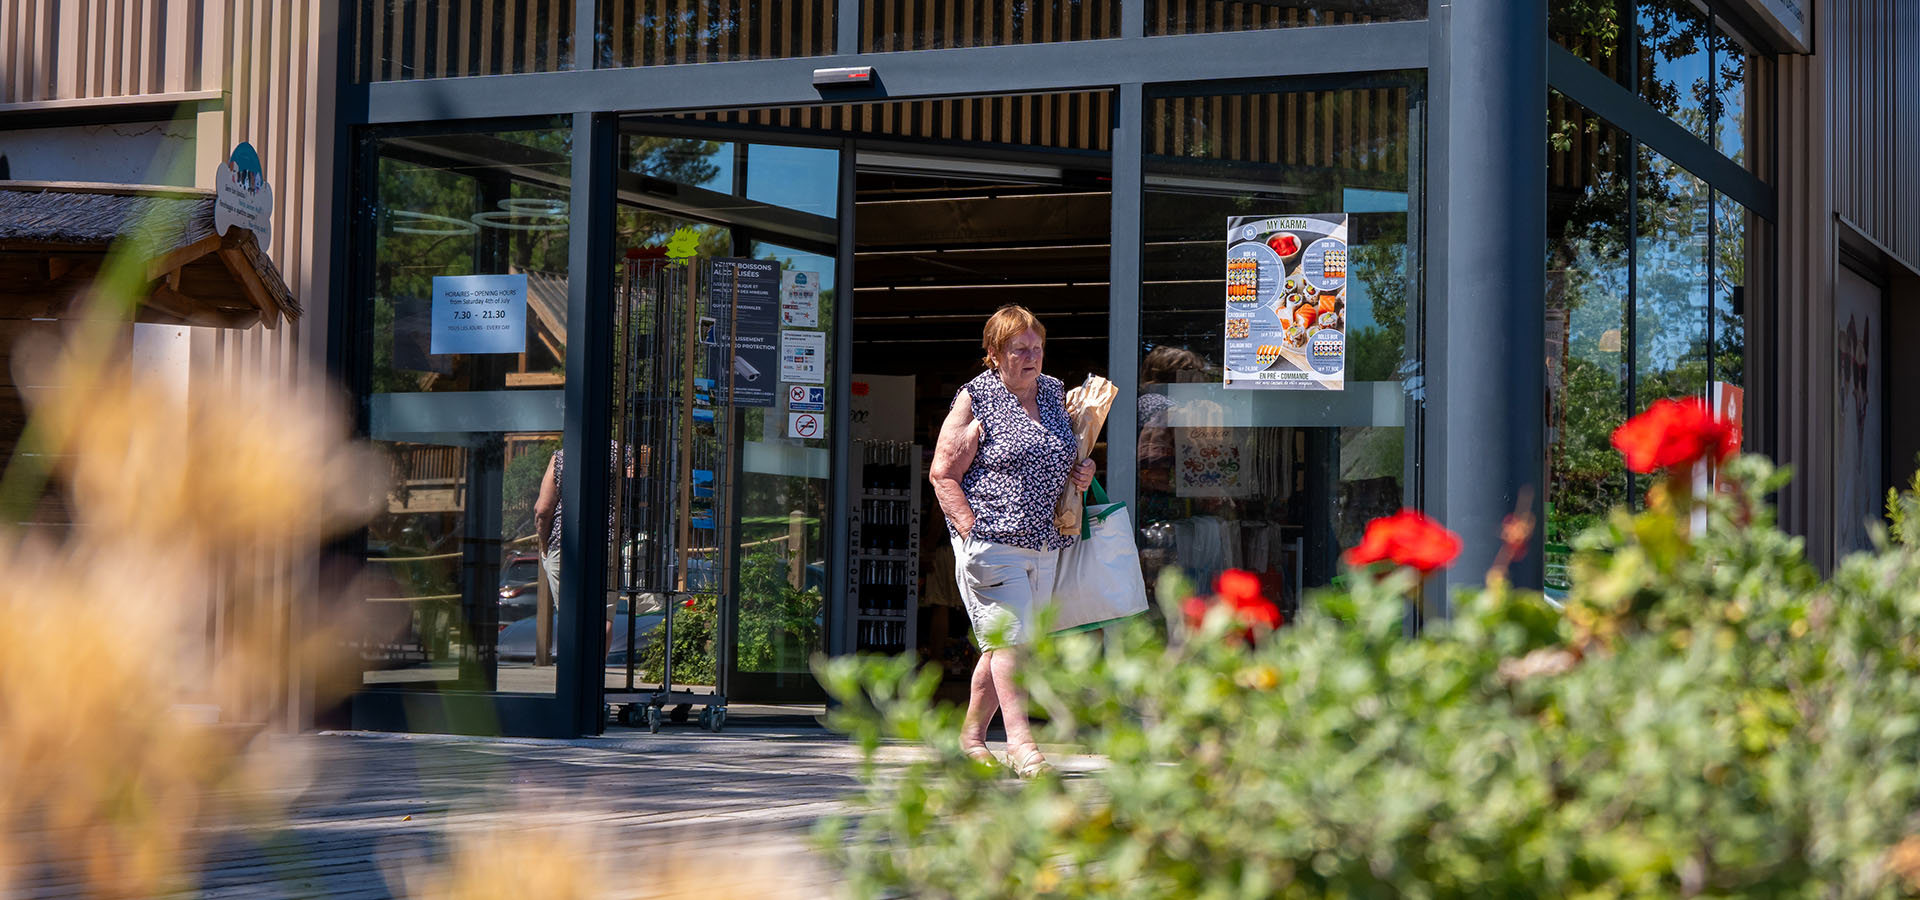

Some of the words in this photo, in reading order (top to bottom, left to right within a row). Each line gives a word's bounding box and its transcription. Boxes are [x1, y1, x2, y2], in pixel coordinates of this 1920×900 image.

[1266, 220, 1278, 229] MY
[1280, 220, 1307, 229] KARMA
[714, 269, 759, 278] ALCOLISÉES
[454, 311, 471, 319] 7.30
[482, 310, 505, 318] 21.30
[849, 530, 859, 593] CERIOLA
[909, 533, 918, 596] CERIOLA
